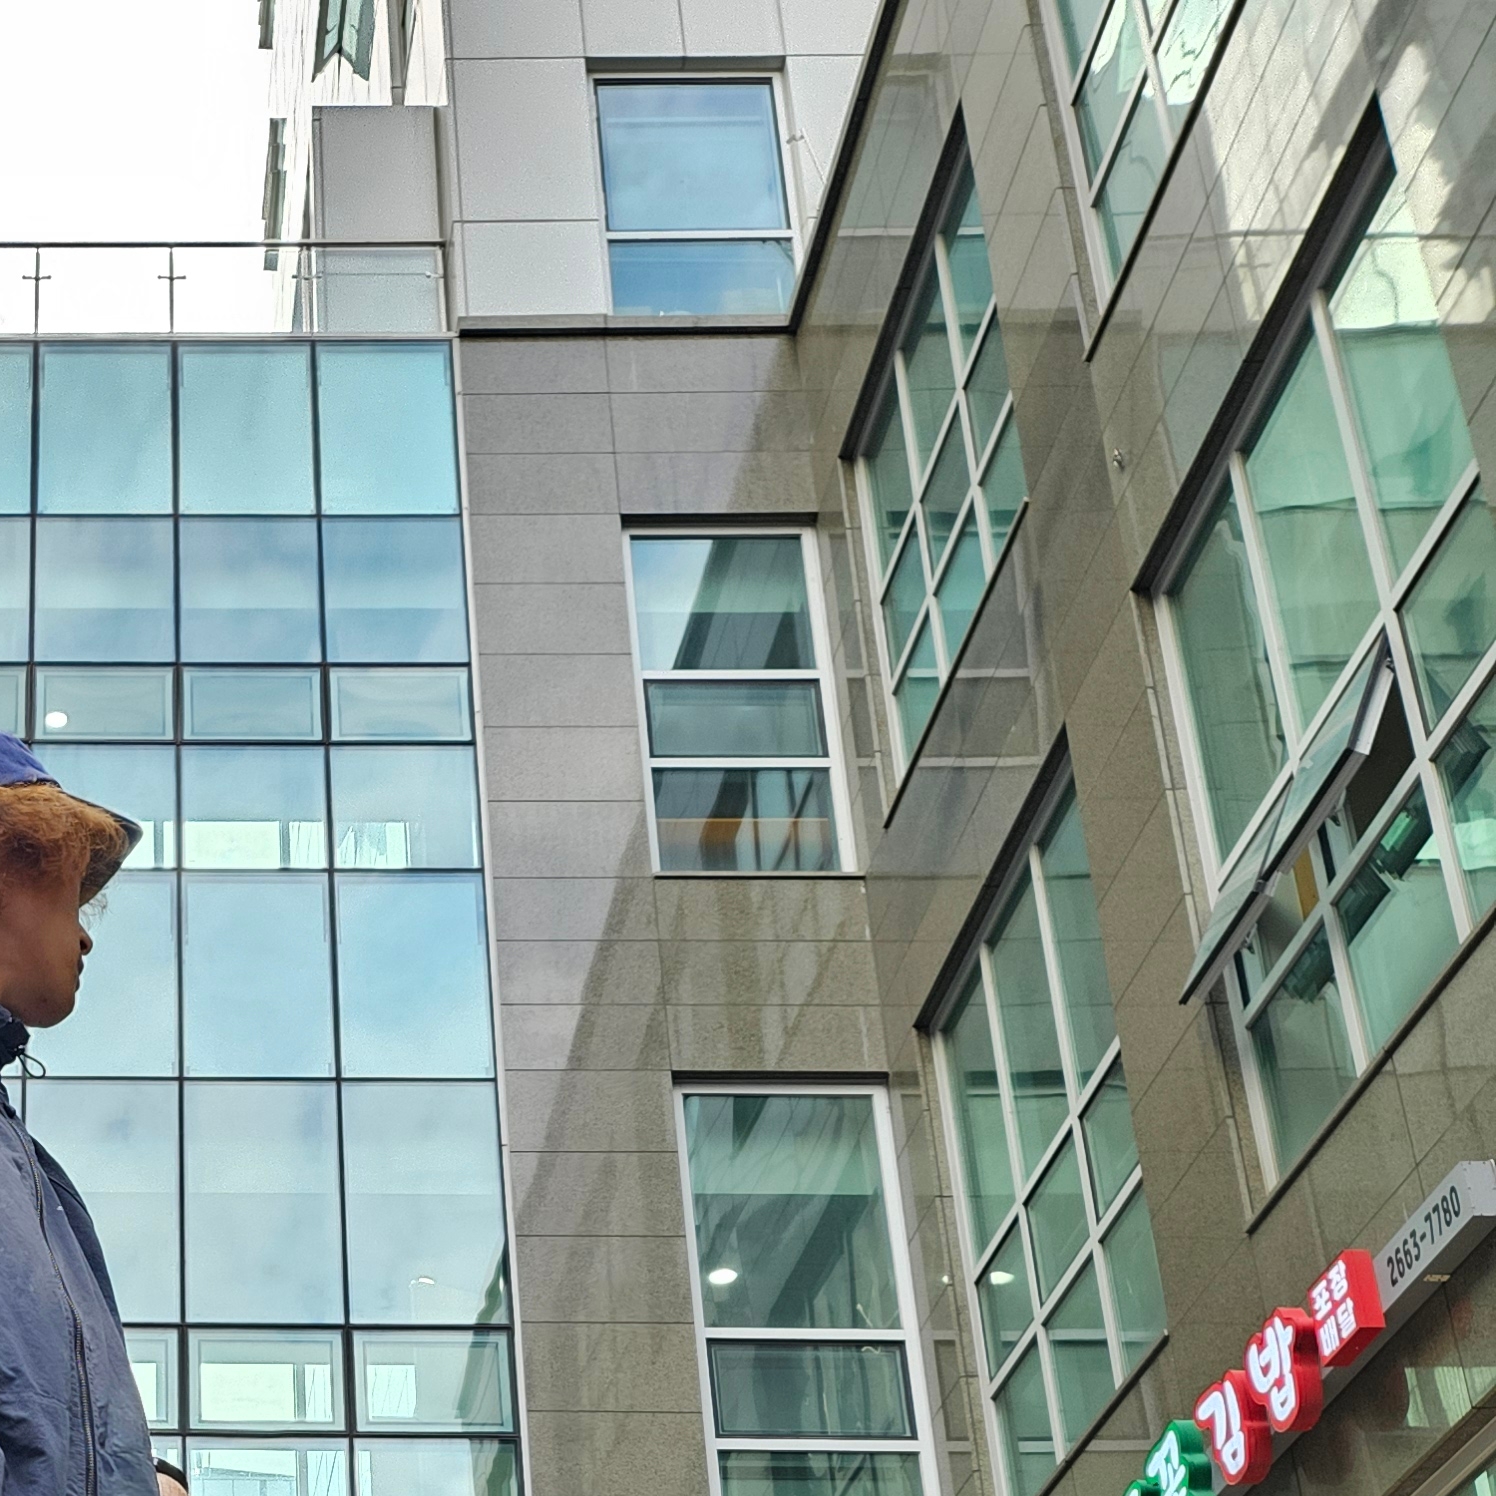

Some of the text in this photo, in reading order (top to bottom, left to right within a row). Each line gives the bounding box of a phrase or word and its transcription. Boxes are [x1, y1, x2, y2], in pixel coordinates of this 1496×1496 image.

[1386, 1185, 1462, 1288] 2663-7780
[1312, 1260, 1349, 1321] 포장
[1319, 1297, 1357, 1356] 배달
